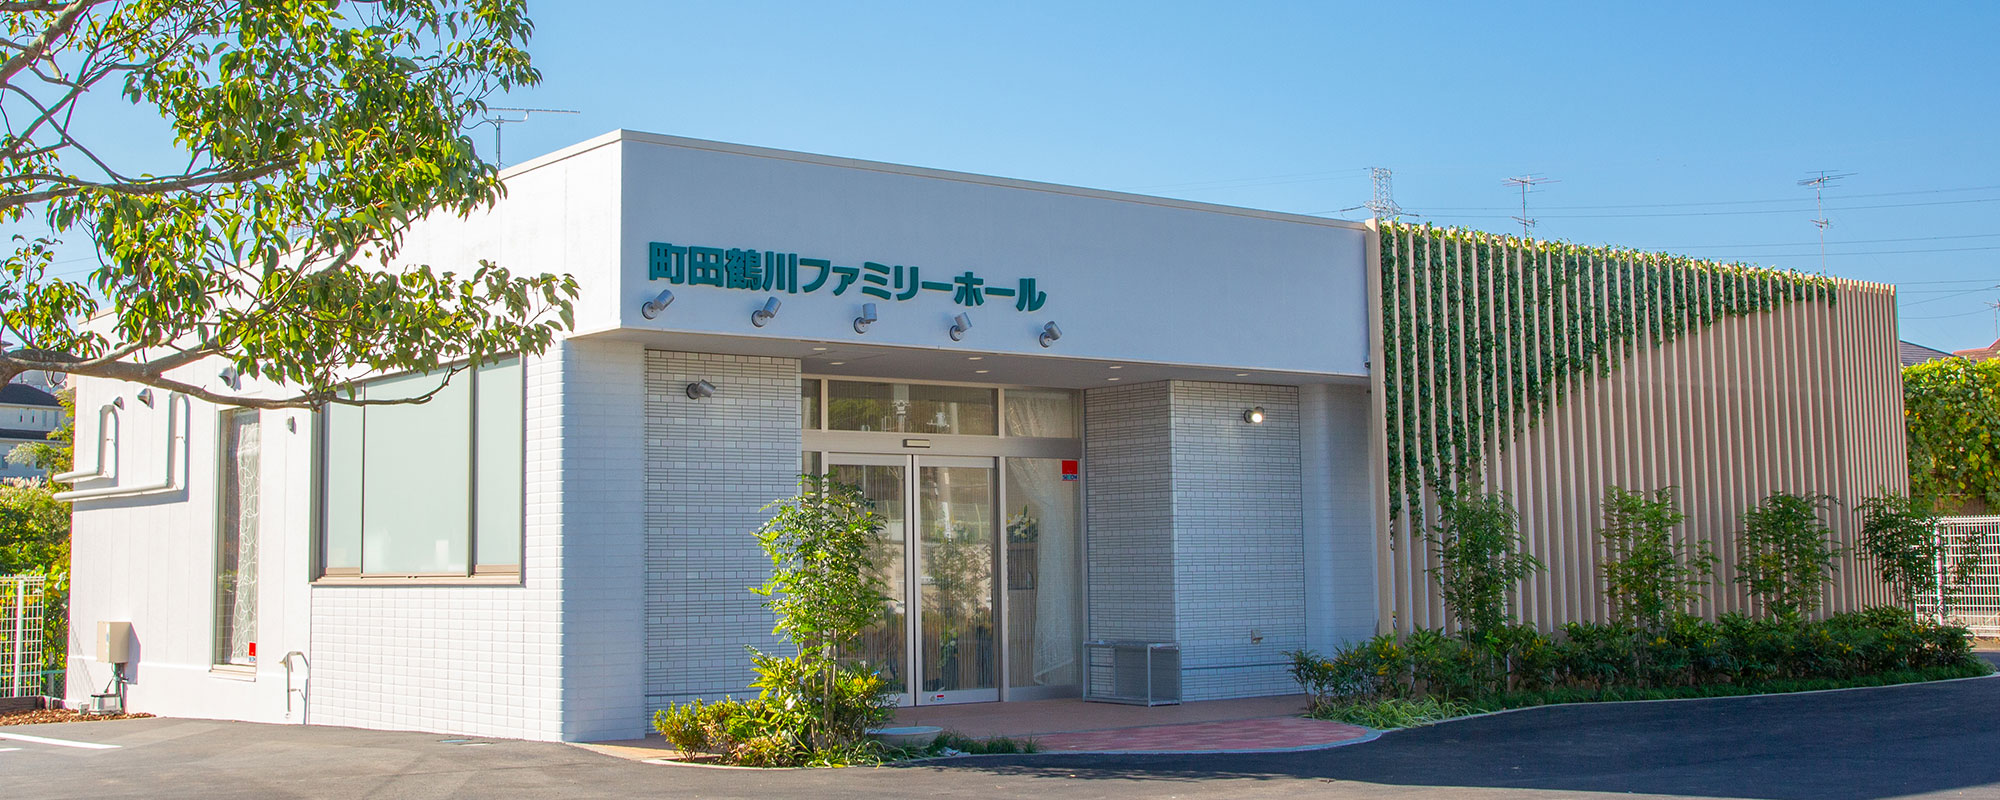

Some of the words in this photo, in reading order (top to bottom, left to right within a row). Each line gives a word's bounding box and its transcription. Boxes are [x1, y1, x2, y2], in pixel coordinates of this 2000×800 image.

[649, 241, 1047, 312] 町田鶴川ファミリーホール
